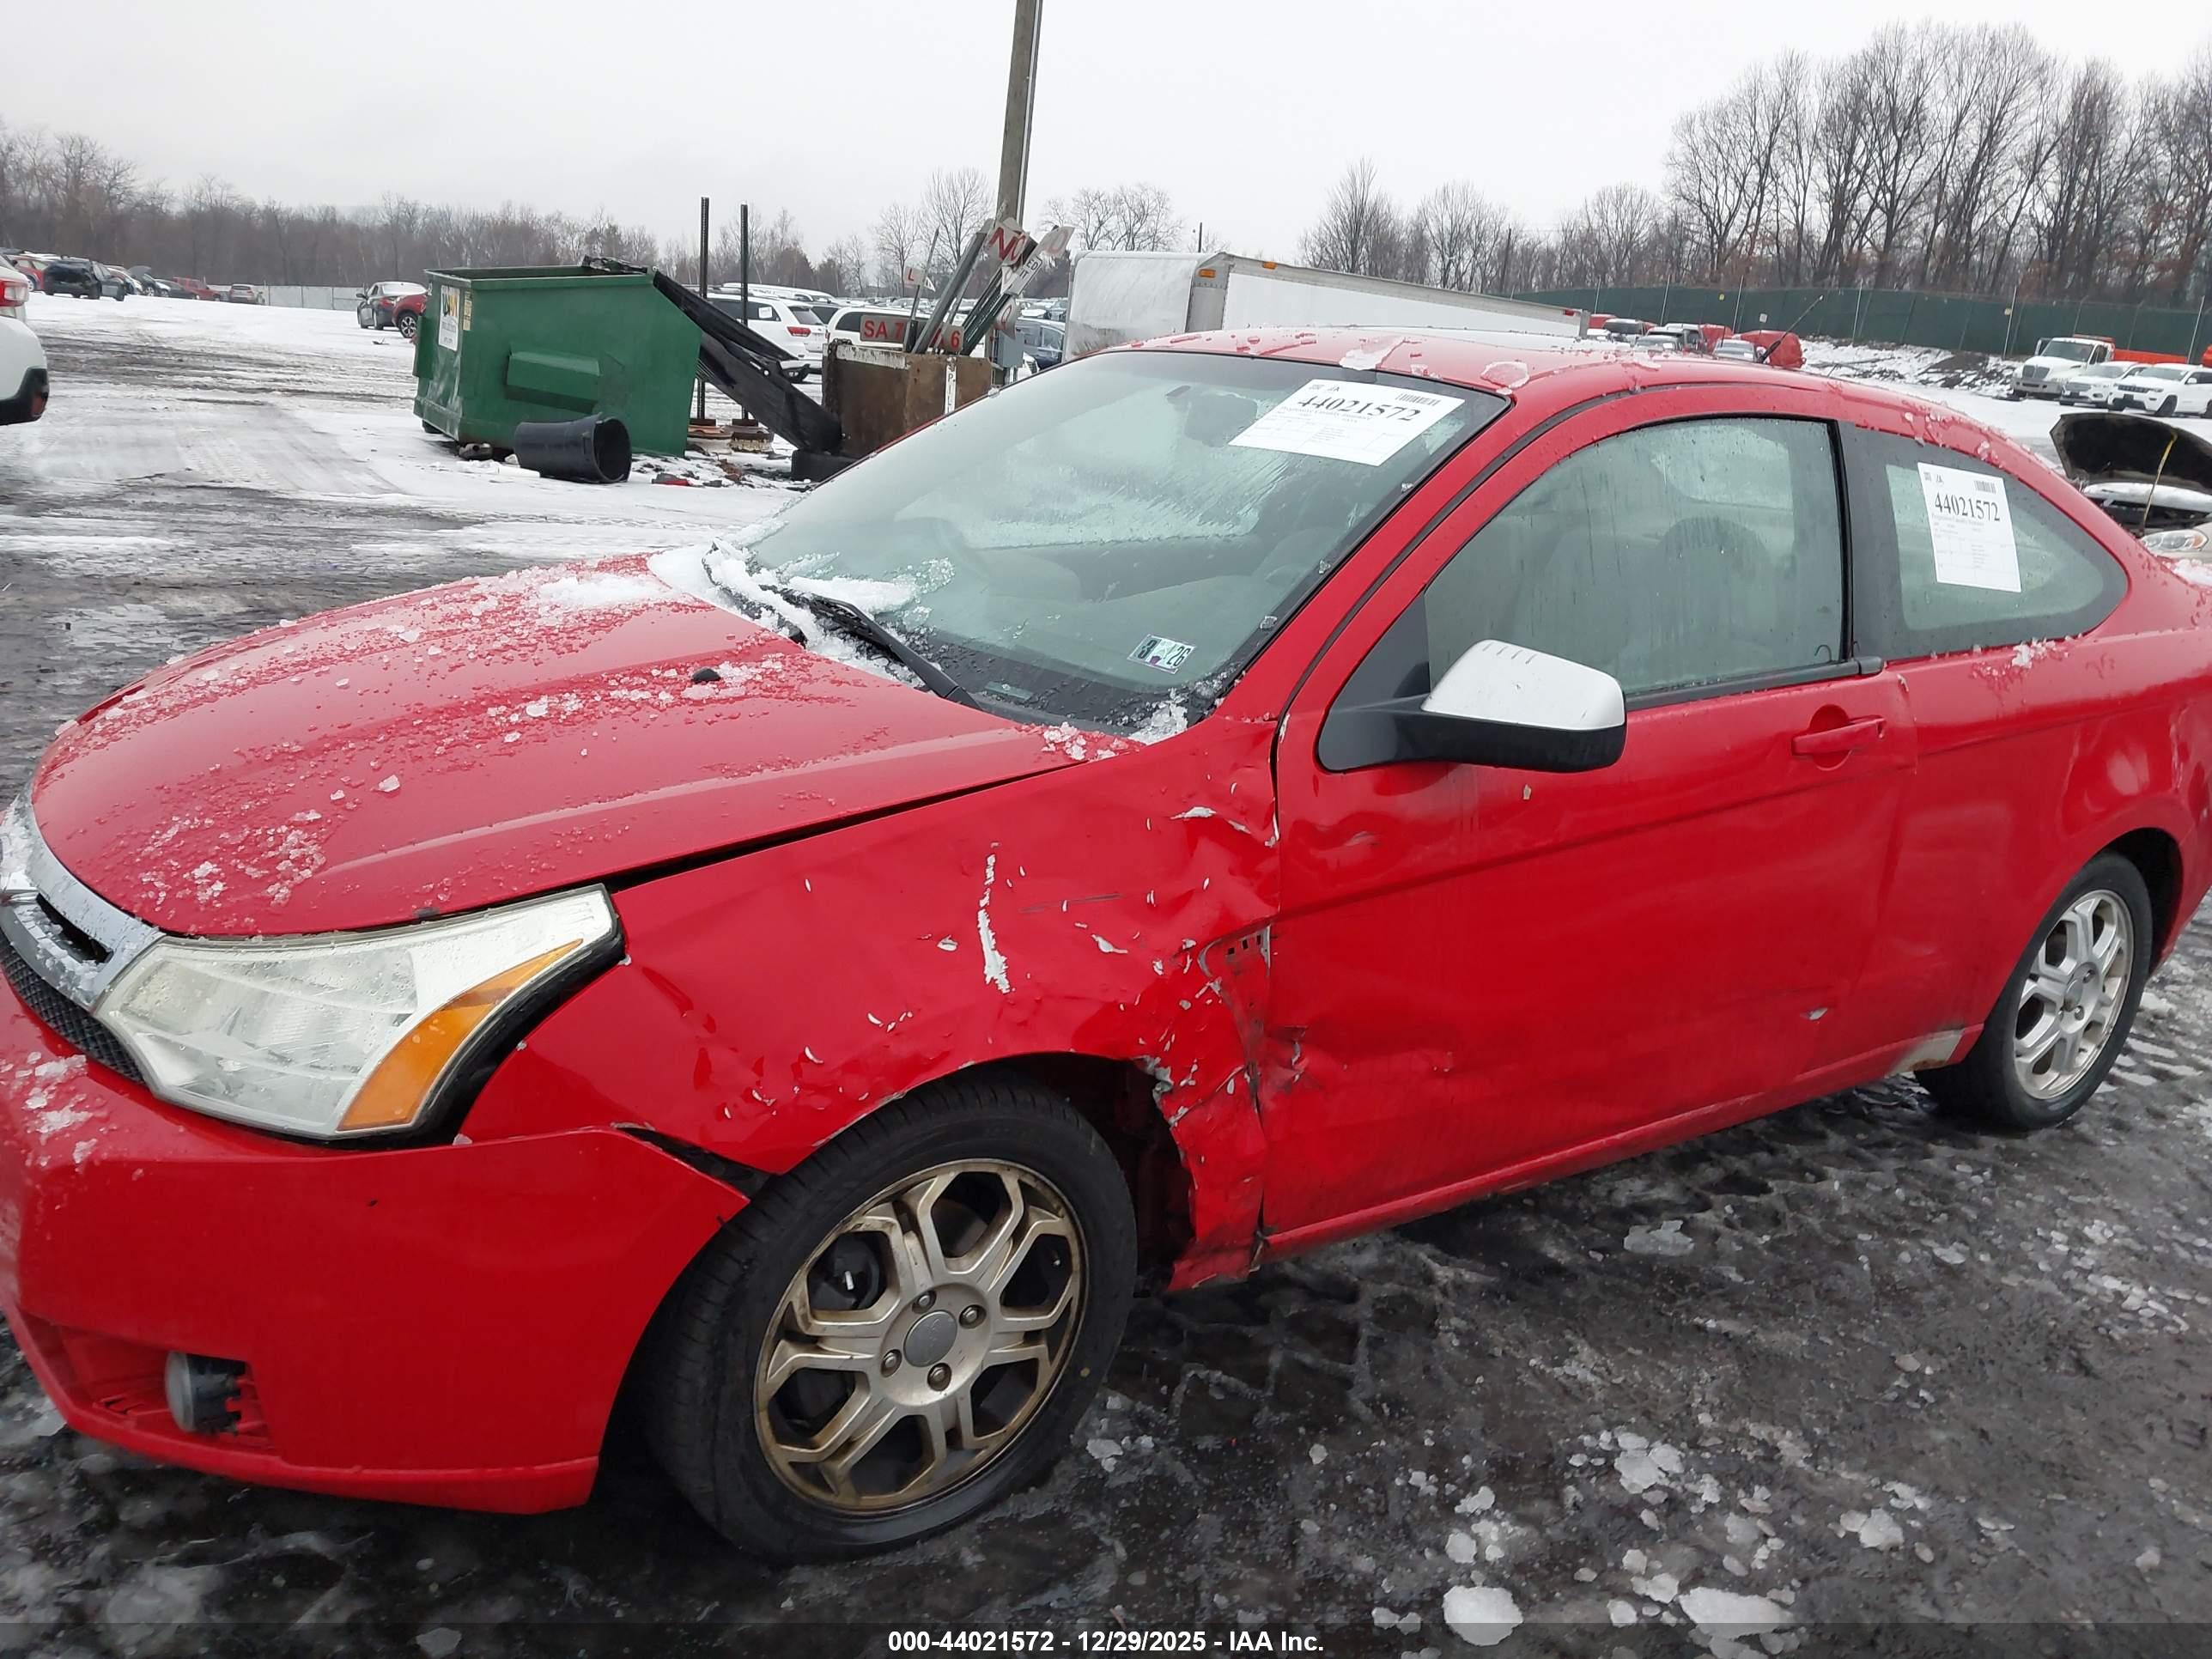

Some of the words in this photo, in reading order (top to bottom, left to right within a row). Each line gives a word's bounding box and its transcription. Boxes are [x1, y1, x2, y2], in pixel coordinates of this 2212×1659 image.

[864, 319, 888, 339] SA
[1297, 394, 1422, 422] 44021572
[1934, 491, 2001, 522] 44021572
[1138, 639, 1158, 659] 3
